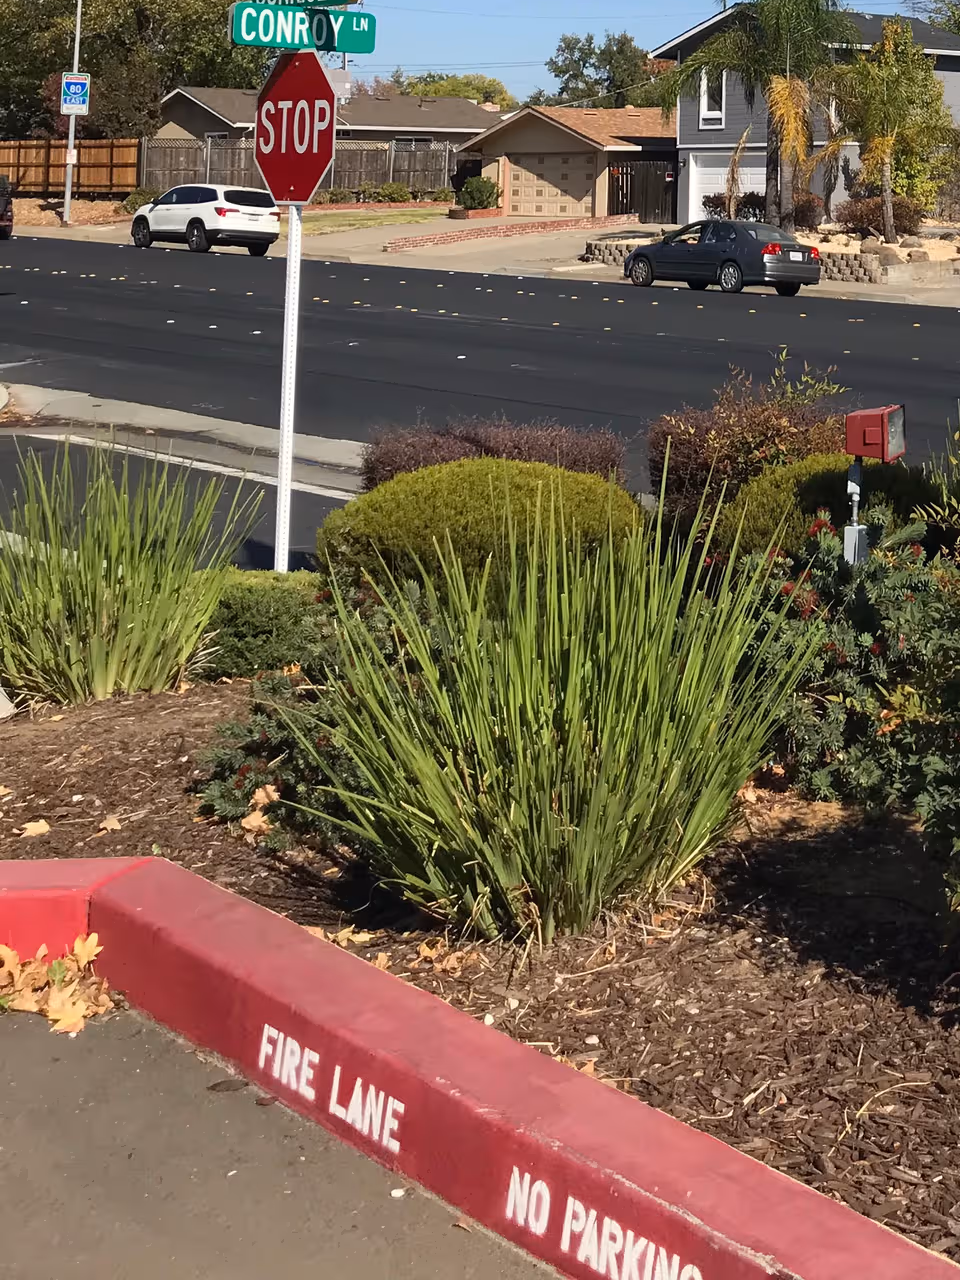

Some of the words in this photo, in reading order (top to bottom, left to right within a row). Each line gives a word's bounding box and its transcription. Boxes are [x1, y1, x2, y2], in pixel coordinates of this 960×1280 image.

[241, 7, 344, 47] CONROY
[353, 17, 368, 31] LN
[66, 96, 83, 104] EAST
[70, 85, 81, 93] 80
[259, 99, 331, 154] STOP
[258, 1023, 320, 1102] FIRE
[328, 1065, 405, 1154] LANE
[506, 1165, 551, 1236] NO
[560, 1195, 703, 1280] PARKIN
